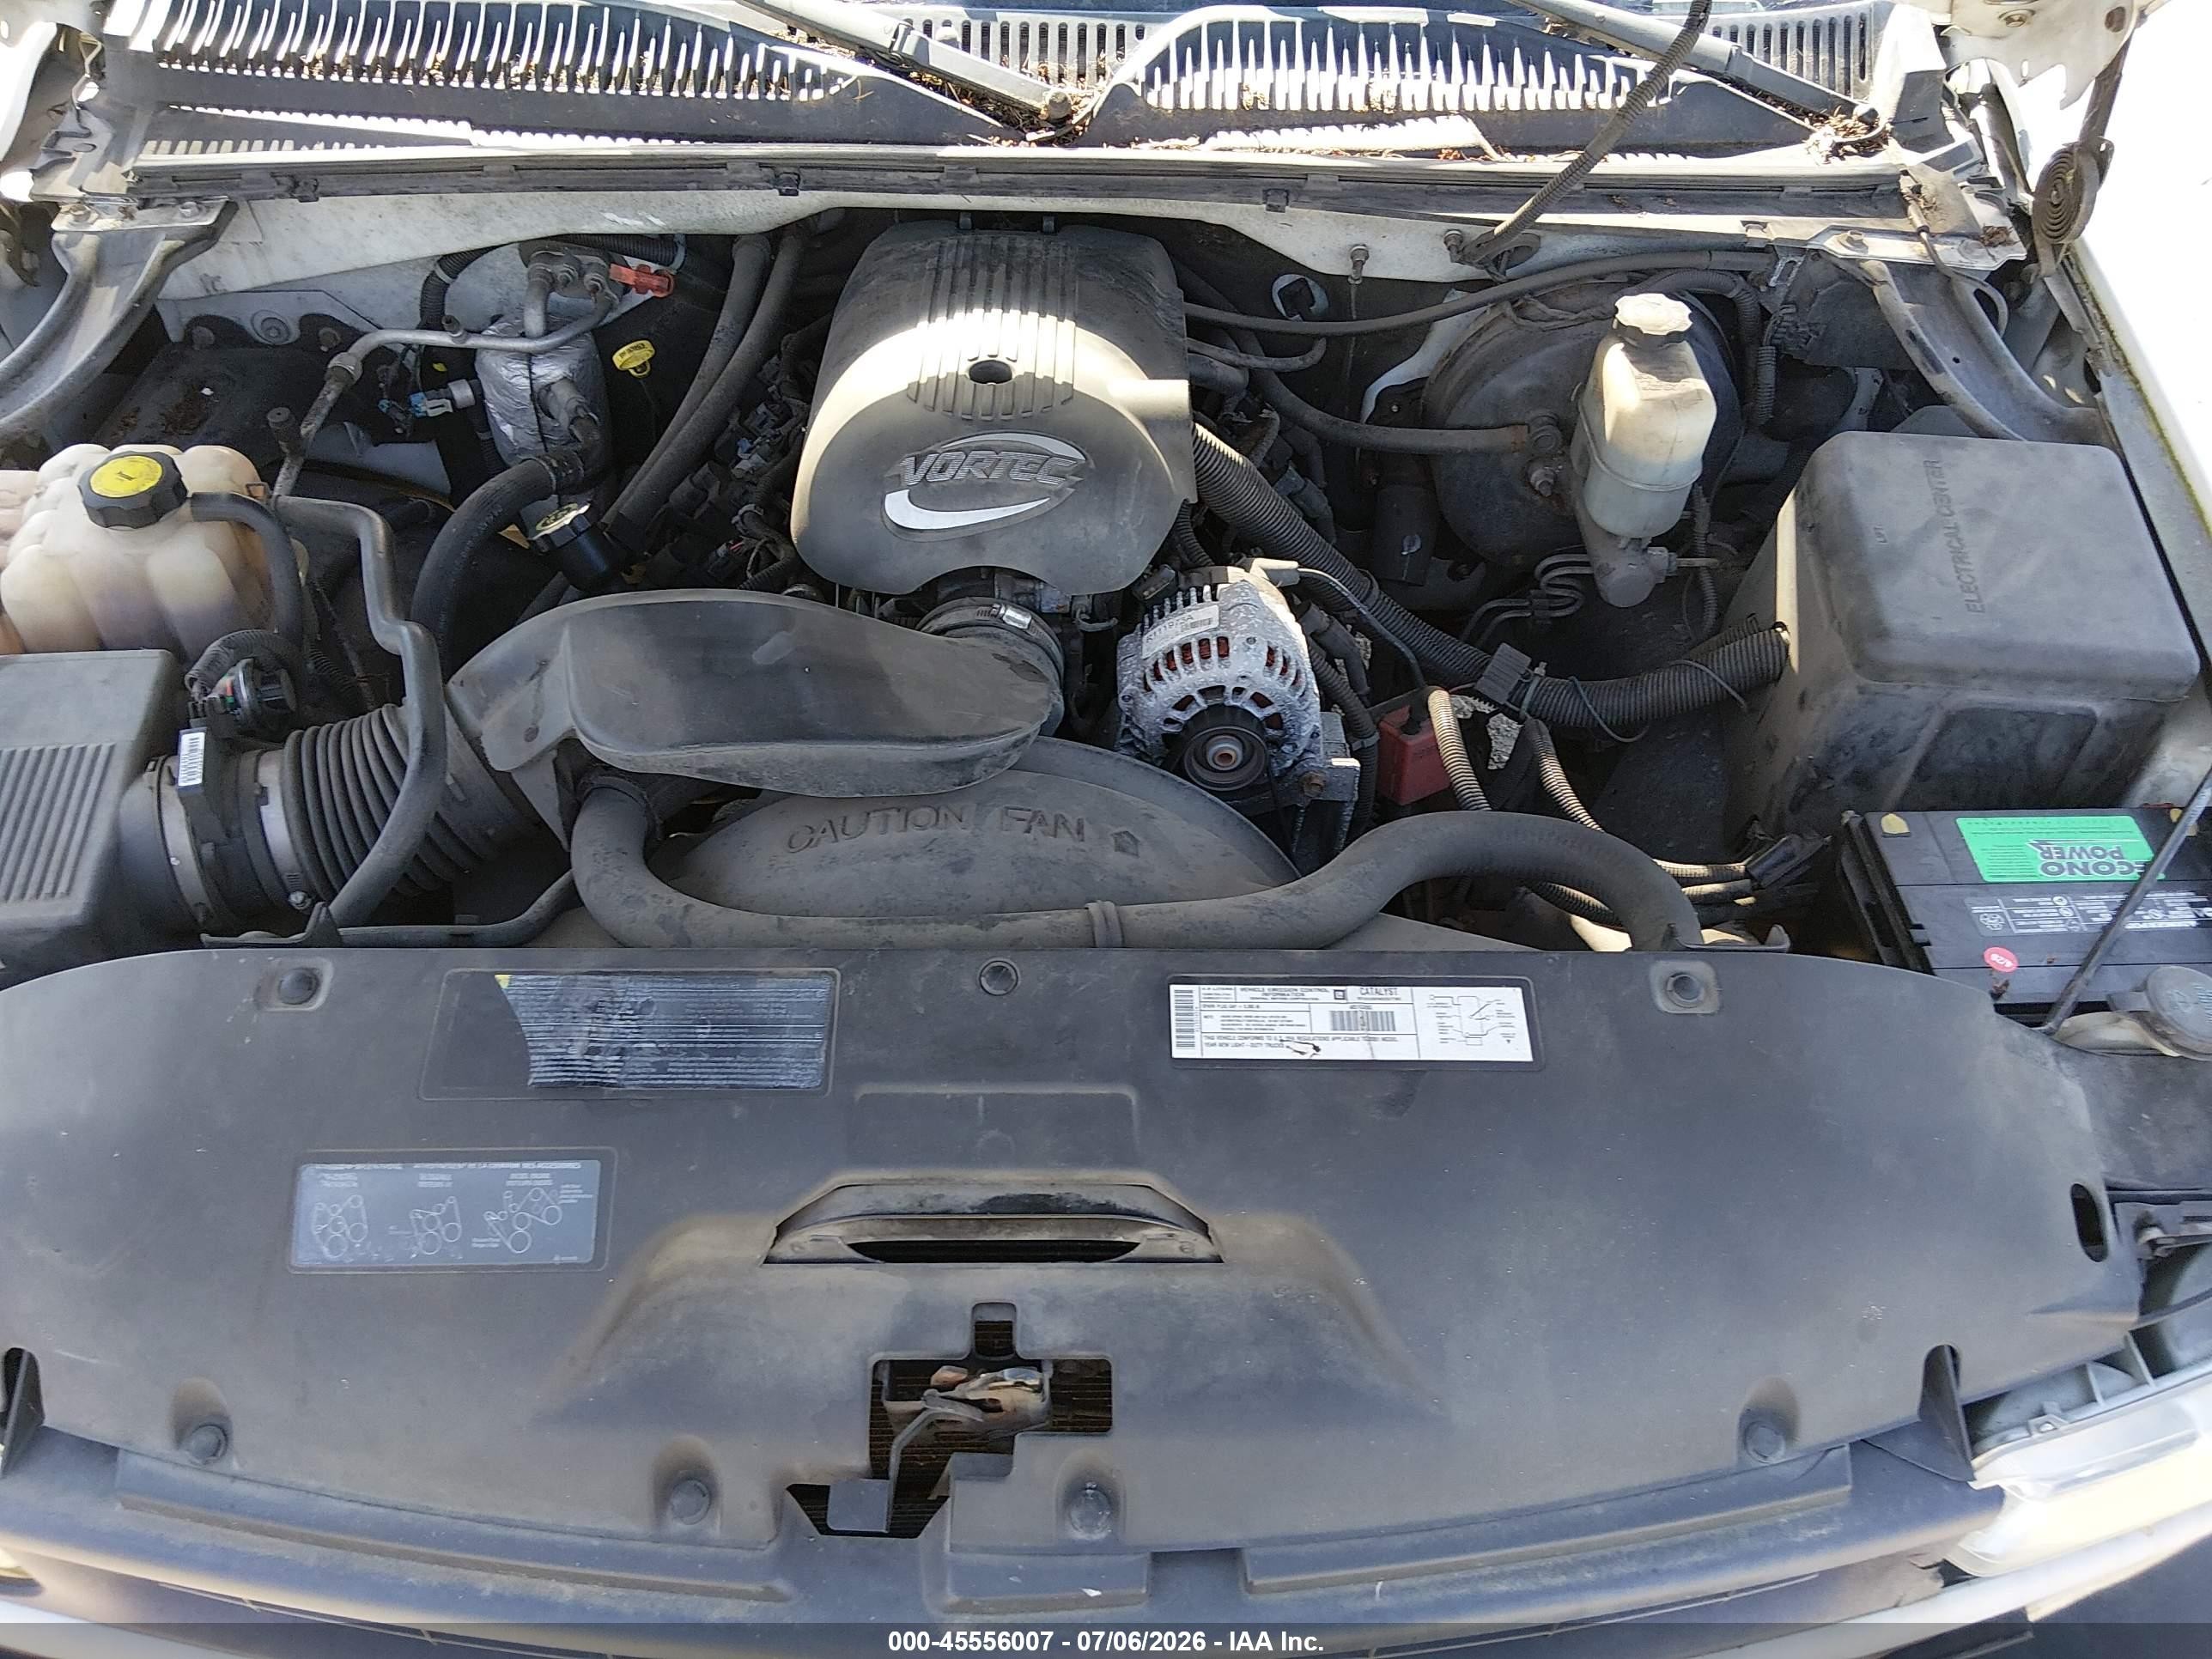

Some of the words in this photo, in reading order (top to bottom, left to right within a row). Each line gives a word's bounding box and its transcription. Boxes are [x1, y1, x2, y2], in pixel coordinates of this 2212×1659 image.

[902, 451, 1080, 485] VORTEC
[1923, 460, 1955, 518] CENTER
[1942, 522, 1985, 614] ELECTRICAL
[787, 805, 967, 853] CAUTION
[1000, 806, 1085, 842] FAN
[2039, 846, 2124, 860] POWER
[1360, 988, 1398, 996] CATALYST
